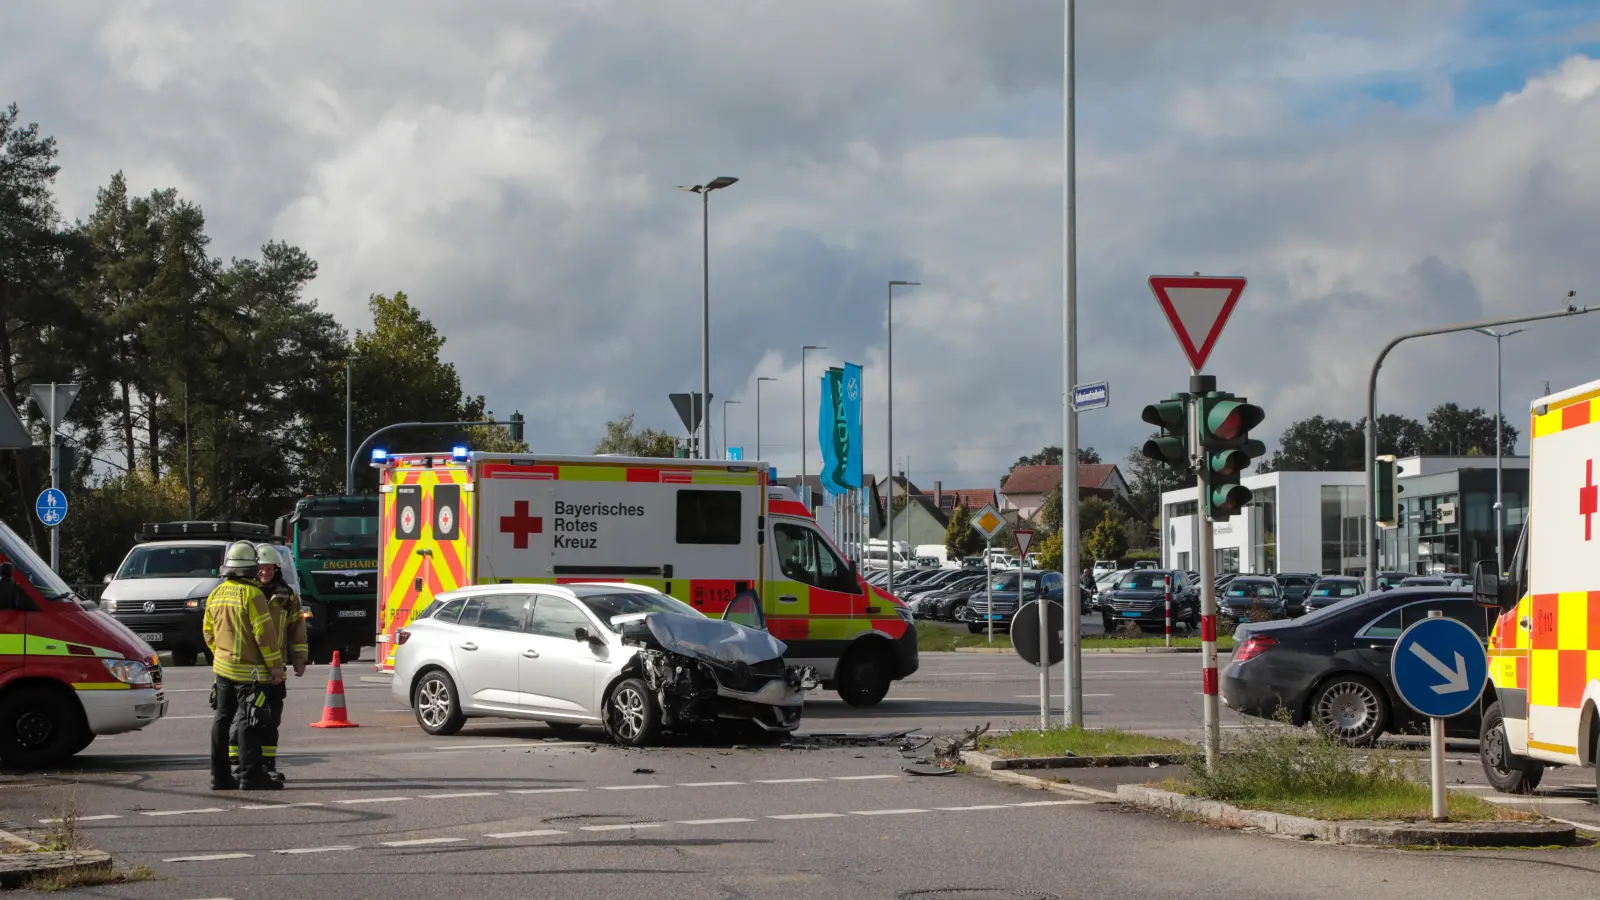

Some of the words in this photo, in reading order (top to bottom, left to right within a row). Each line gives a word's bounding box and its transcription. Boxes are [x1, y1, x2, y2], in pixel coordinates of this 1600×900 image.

[554, 500, 645, 518] Bayerisches
[554, 517, 598, 532] Rotes
[554, 534, 598, 549] Kreuz
[334, 580, 369, 588] MAN
[710, 588, 730, 602] 112
[390, 608, 424, 621] RETTUN
